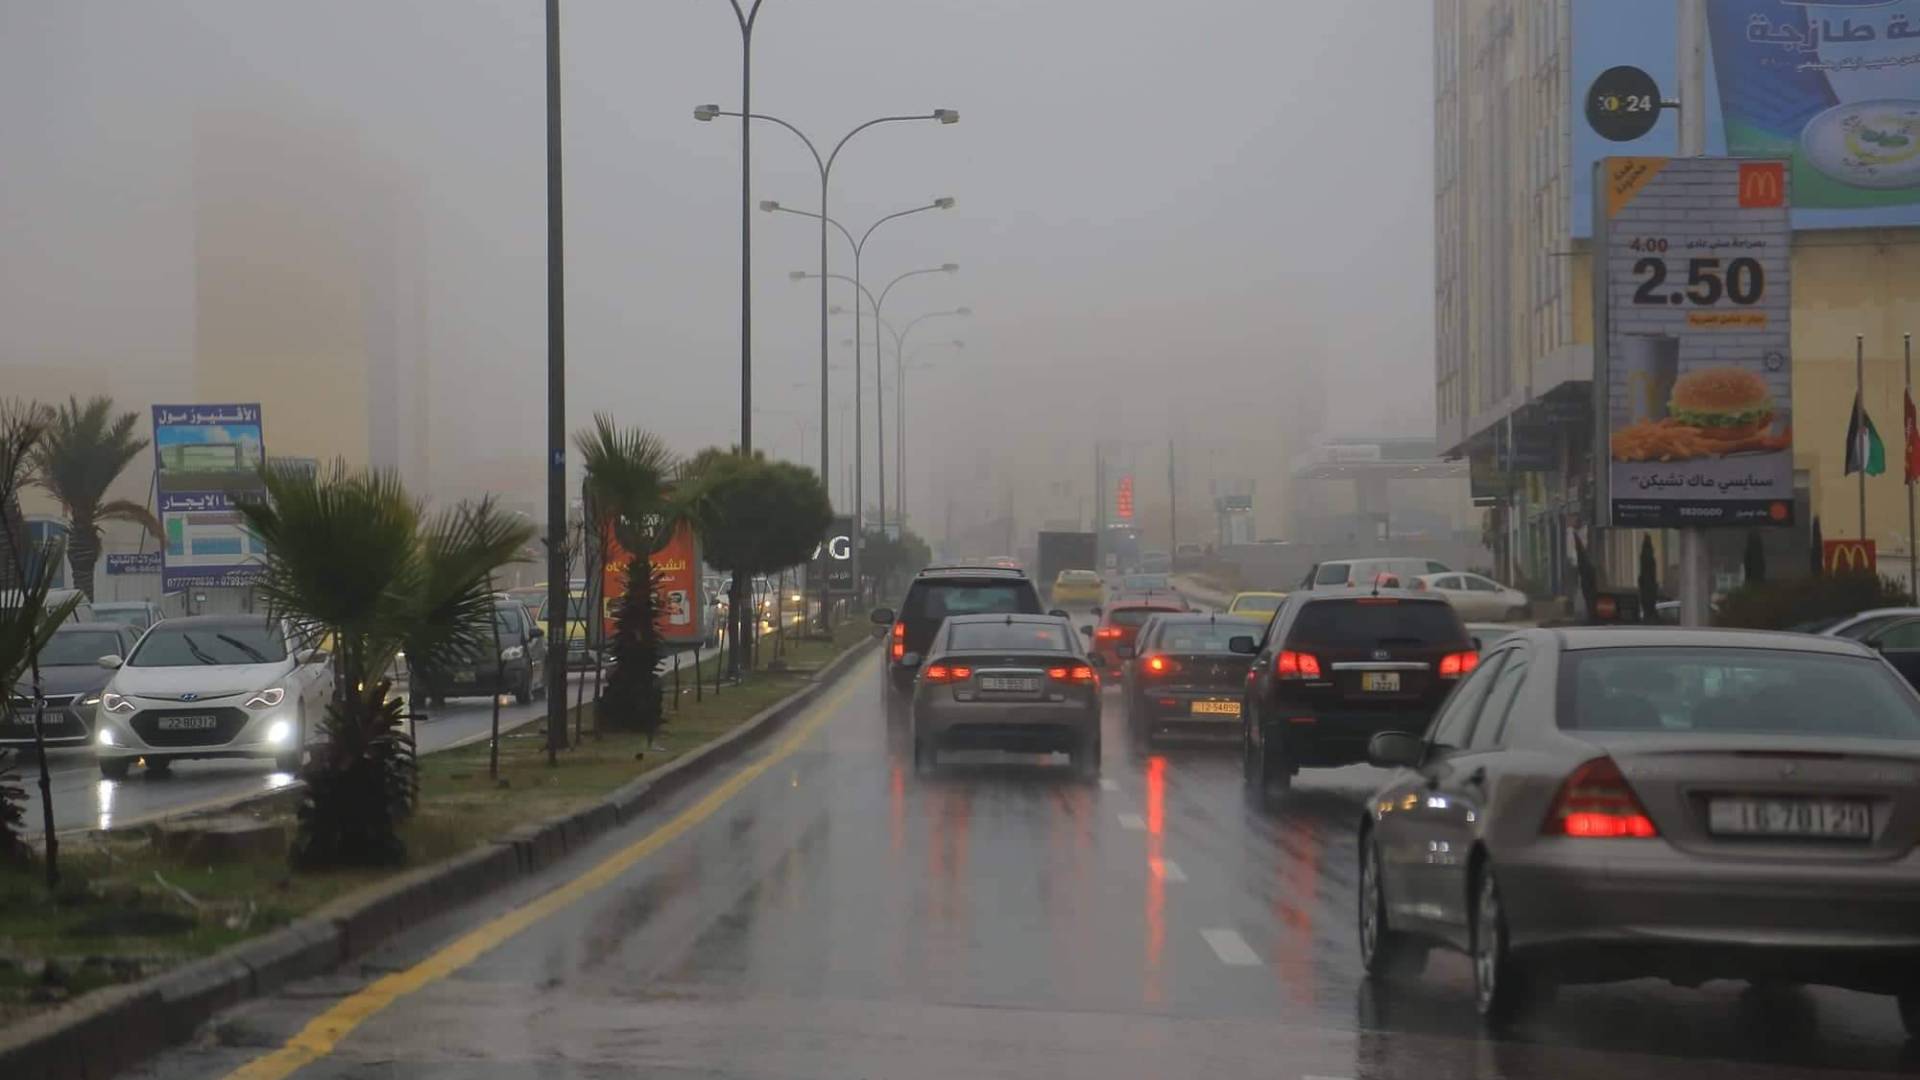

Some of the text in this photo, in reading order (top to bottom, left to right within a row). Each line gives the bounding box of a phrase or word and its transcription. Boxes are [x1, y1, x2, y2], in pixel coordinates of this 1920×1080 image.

[1747, 12, 1876, 51] طازجة
[1626, 95, 1652, 112] 24
[1631, 238, 1669, 253] 4.00
[1633, 257, 1764, 305] 2.50
[1687, 474, 1714, 488] ماك
